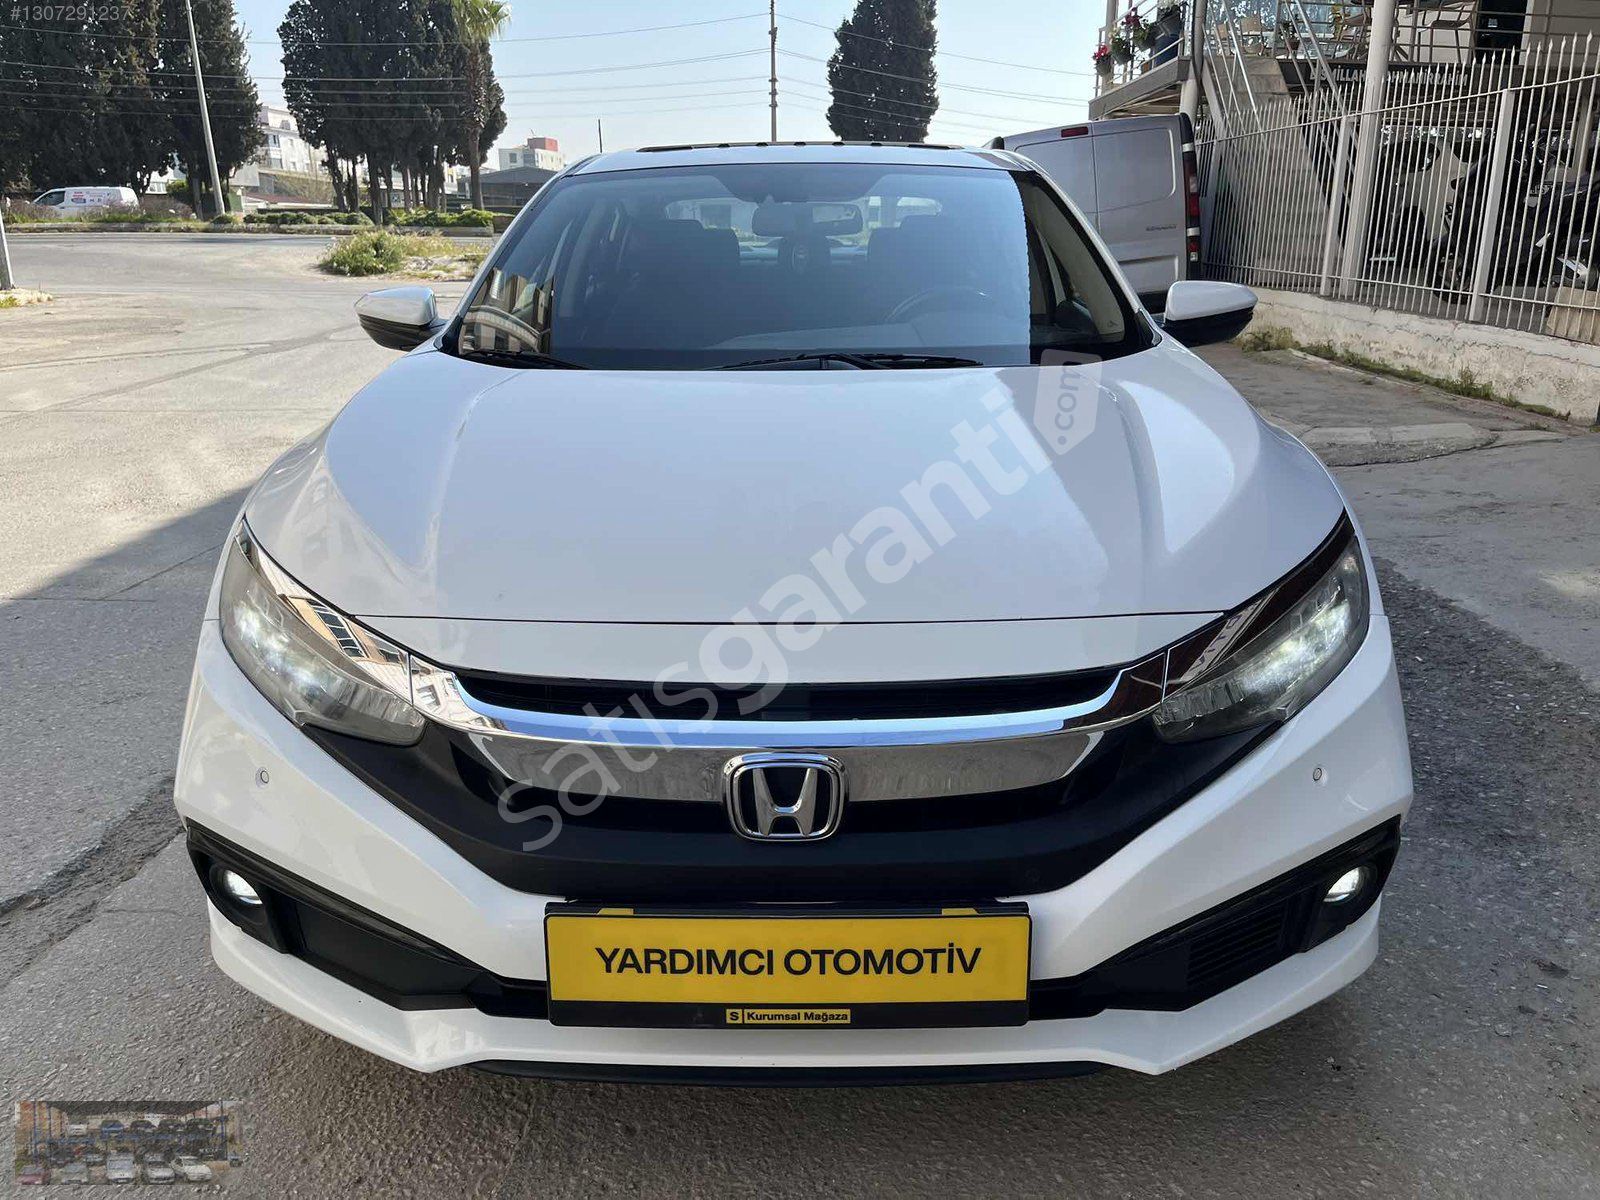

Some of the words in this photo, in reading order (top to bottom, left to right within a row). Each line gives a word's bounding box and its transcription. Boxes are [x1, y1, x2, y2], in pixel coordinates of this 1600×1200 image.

[595, 947, 774, 976] YARDIMCI
[783, 942, 982, 976] OTOMOTİV
[747, 1011, 800, 1021] Kurumsal
[804, 1010, 849, 1022] Mağaza
